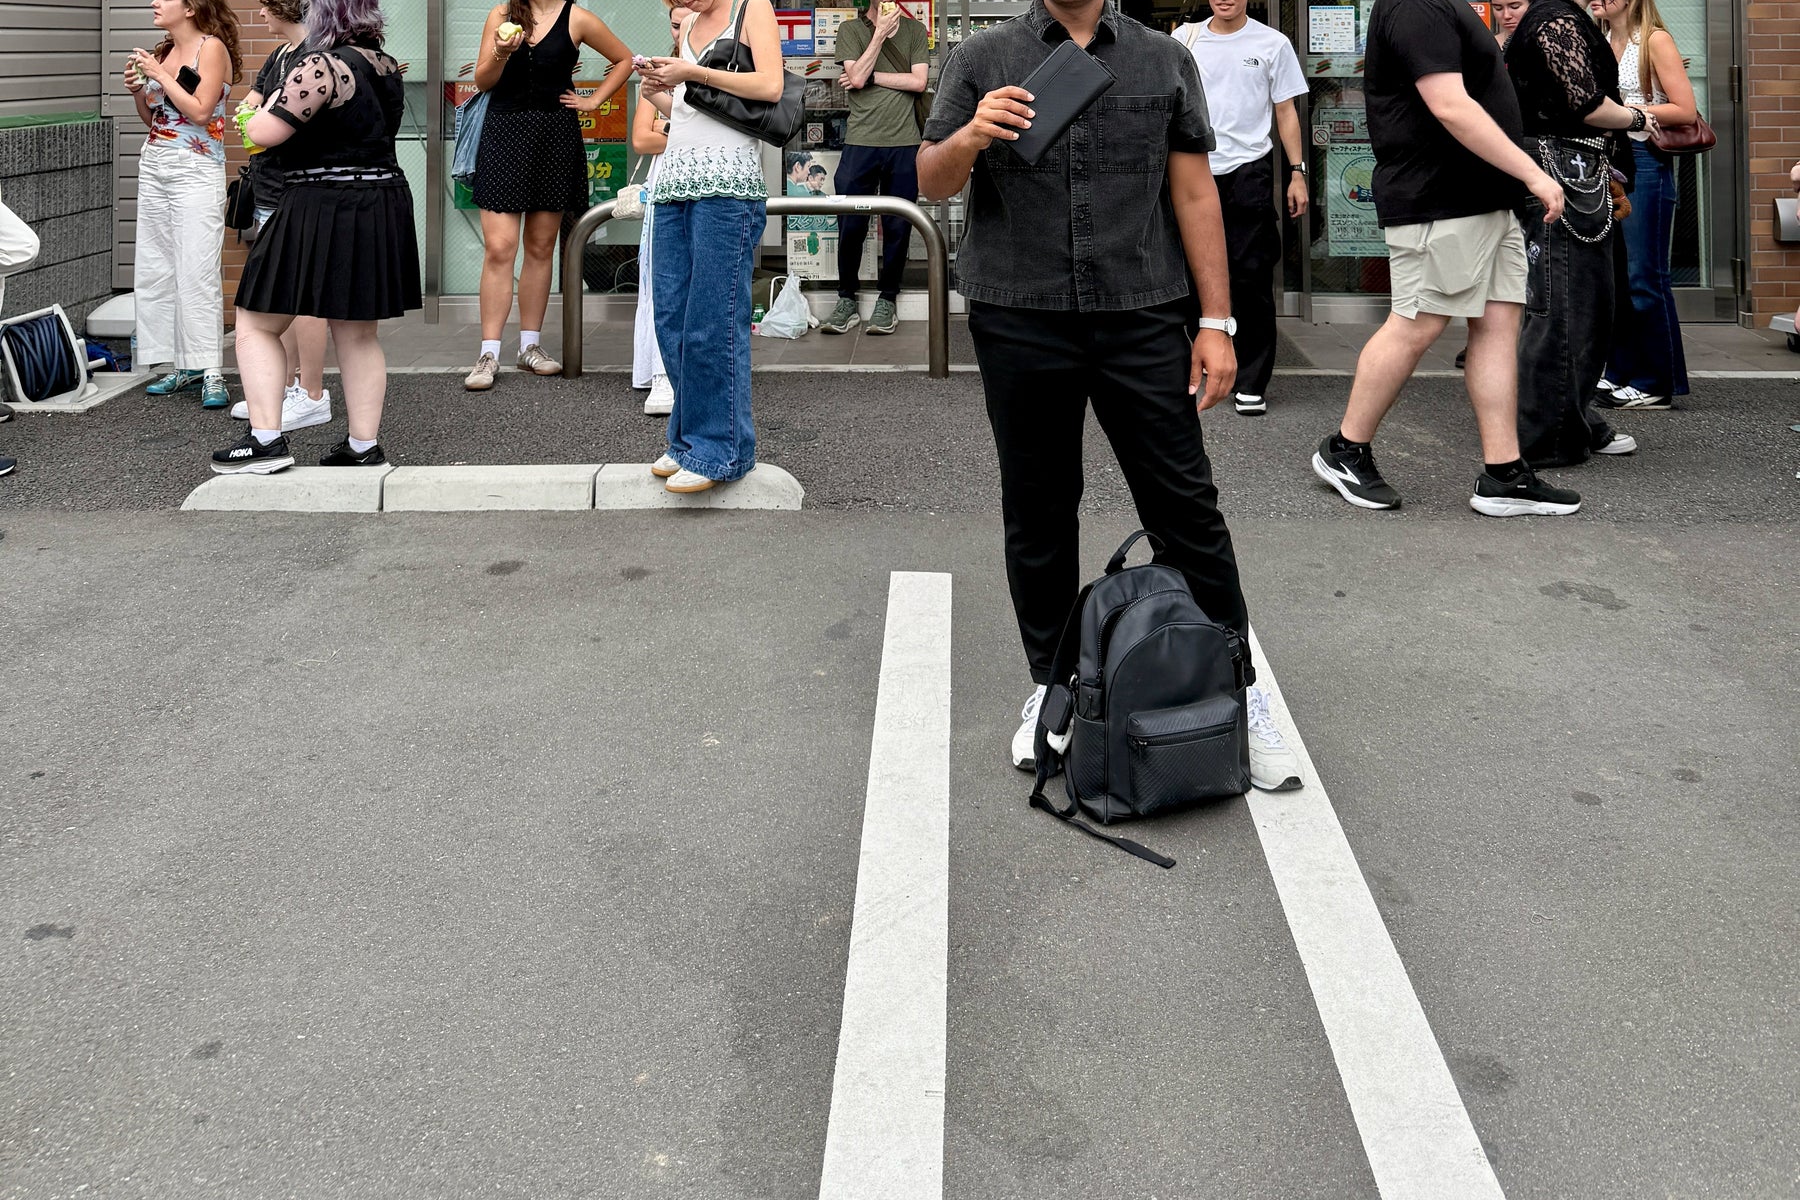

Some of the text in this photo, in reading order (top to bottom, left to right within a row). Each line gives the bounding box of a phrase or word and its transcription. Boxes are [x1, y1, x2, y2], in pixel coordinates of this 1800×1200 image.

[457, 85, 479, 93] 7NO
[587, 161, 613, 179] 0分
[228, 447, 253, 458] HOKA
